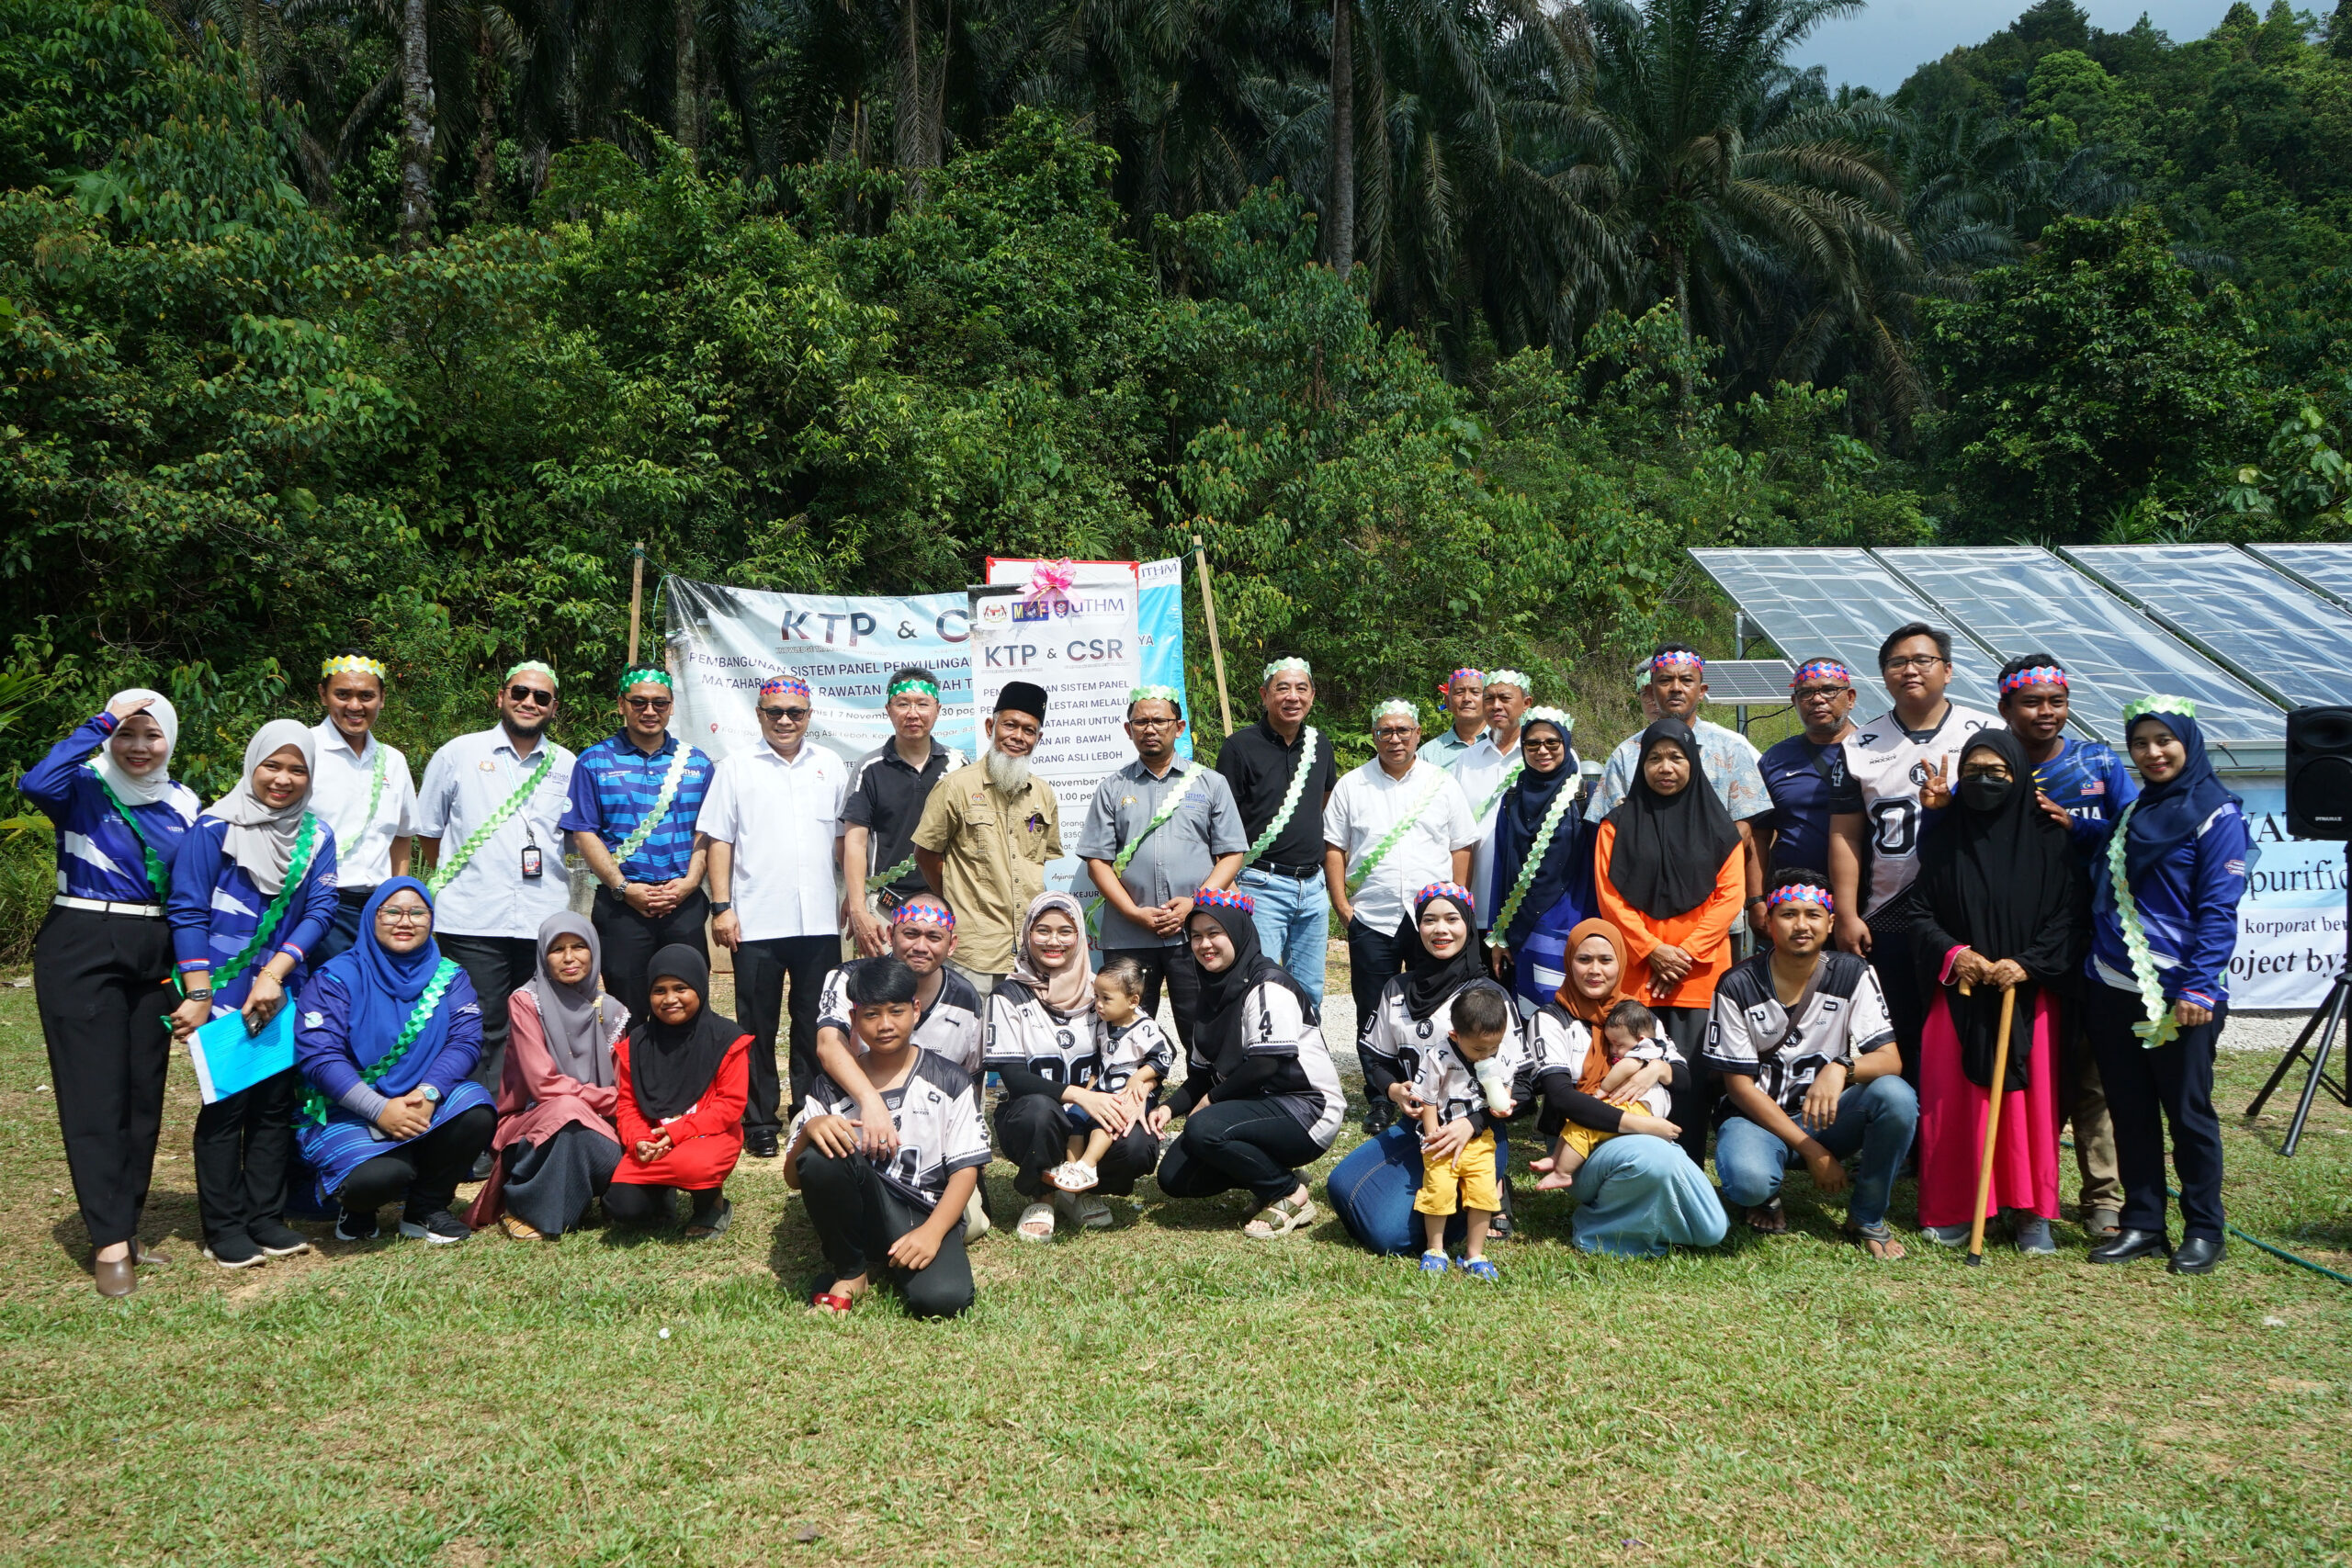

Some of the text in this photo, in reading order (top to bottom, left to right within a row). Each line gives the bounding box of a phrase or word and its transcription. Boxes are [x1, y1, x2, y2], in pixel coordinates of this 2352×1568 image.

[1142, 563, 1177, 578] THM
[781, 609, 970, 647] KTP & C
[1138, 635, 1154, 646] YA
[985, 638, 1124, 668] KTP & CSR
[689, 652, 786, 674] PEMBANGUNAN
[791, 665, 835, 677] SISTEM
[840, 660, 880, 675] PANEL
[884, 657, 971, 671] PENYULINGA
[819, 684, 881, 697] RAWATAN
[1060, 682, 1096, 692] SISTEM
[1099, 681, 1129, 689] PANEL
[1049, 697, 1129, 710] LESTARI MELALU
[1043, 716, 1121, 728] ATAHARI UNTUK
[1055, 736, 1071, 745] AIR
[1076, 734, 1112, 744] BAWAH
[1032, 750, 1123, 764] ORANG ASLI LEBOH
[1048, 777, 1099, 787] November
[1059, 792, 1078, 801] 1.00
[1073, 890, 1100, 898] KEJUR
[2245, 917, 2317, 937] korporat
[2229, 949, 2297, 981] oject
